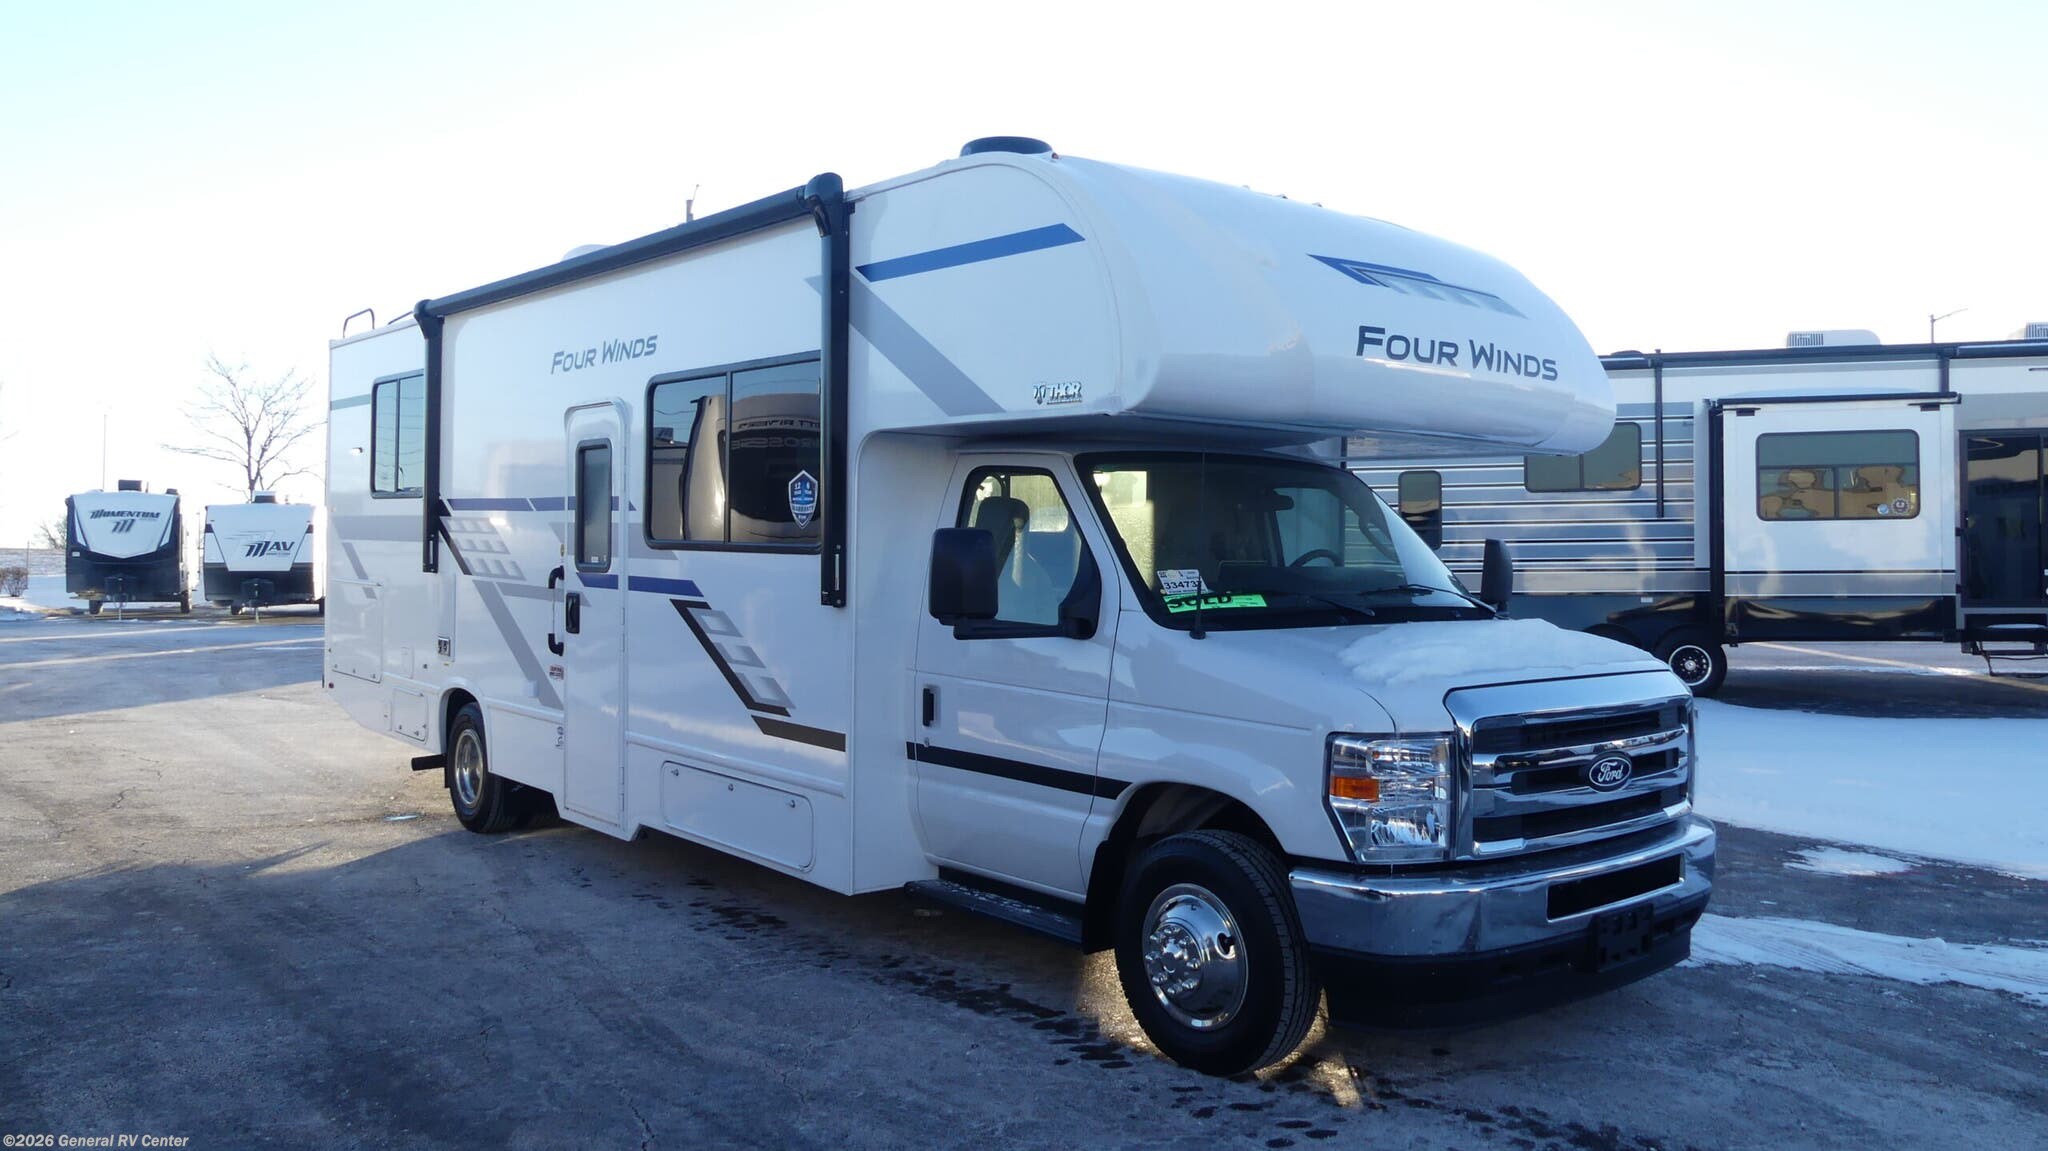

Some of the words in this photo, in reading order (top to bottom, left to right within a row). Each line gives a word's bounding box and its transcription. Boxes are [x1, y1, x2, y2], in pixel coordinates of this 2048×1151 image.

[551, 348, 597, 375] FOUR
[602, 334, 658, 364] WINDS
[1356, 325, 1459, 367] FOUR
[1469, 339, 1559, 382] WINDS
[90, 509, 161, 519] MOMENTUM
[245, 540, 295, 557] MAV
[1597, 761, 1625, 782] Ford
